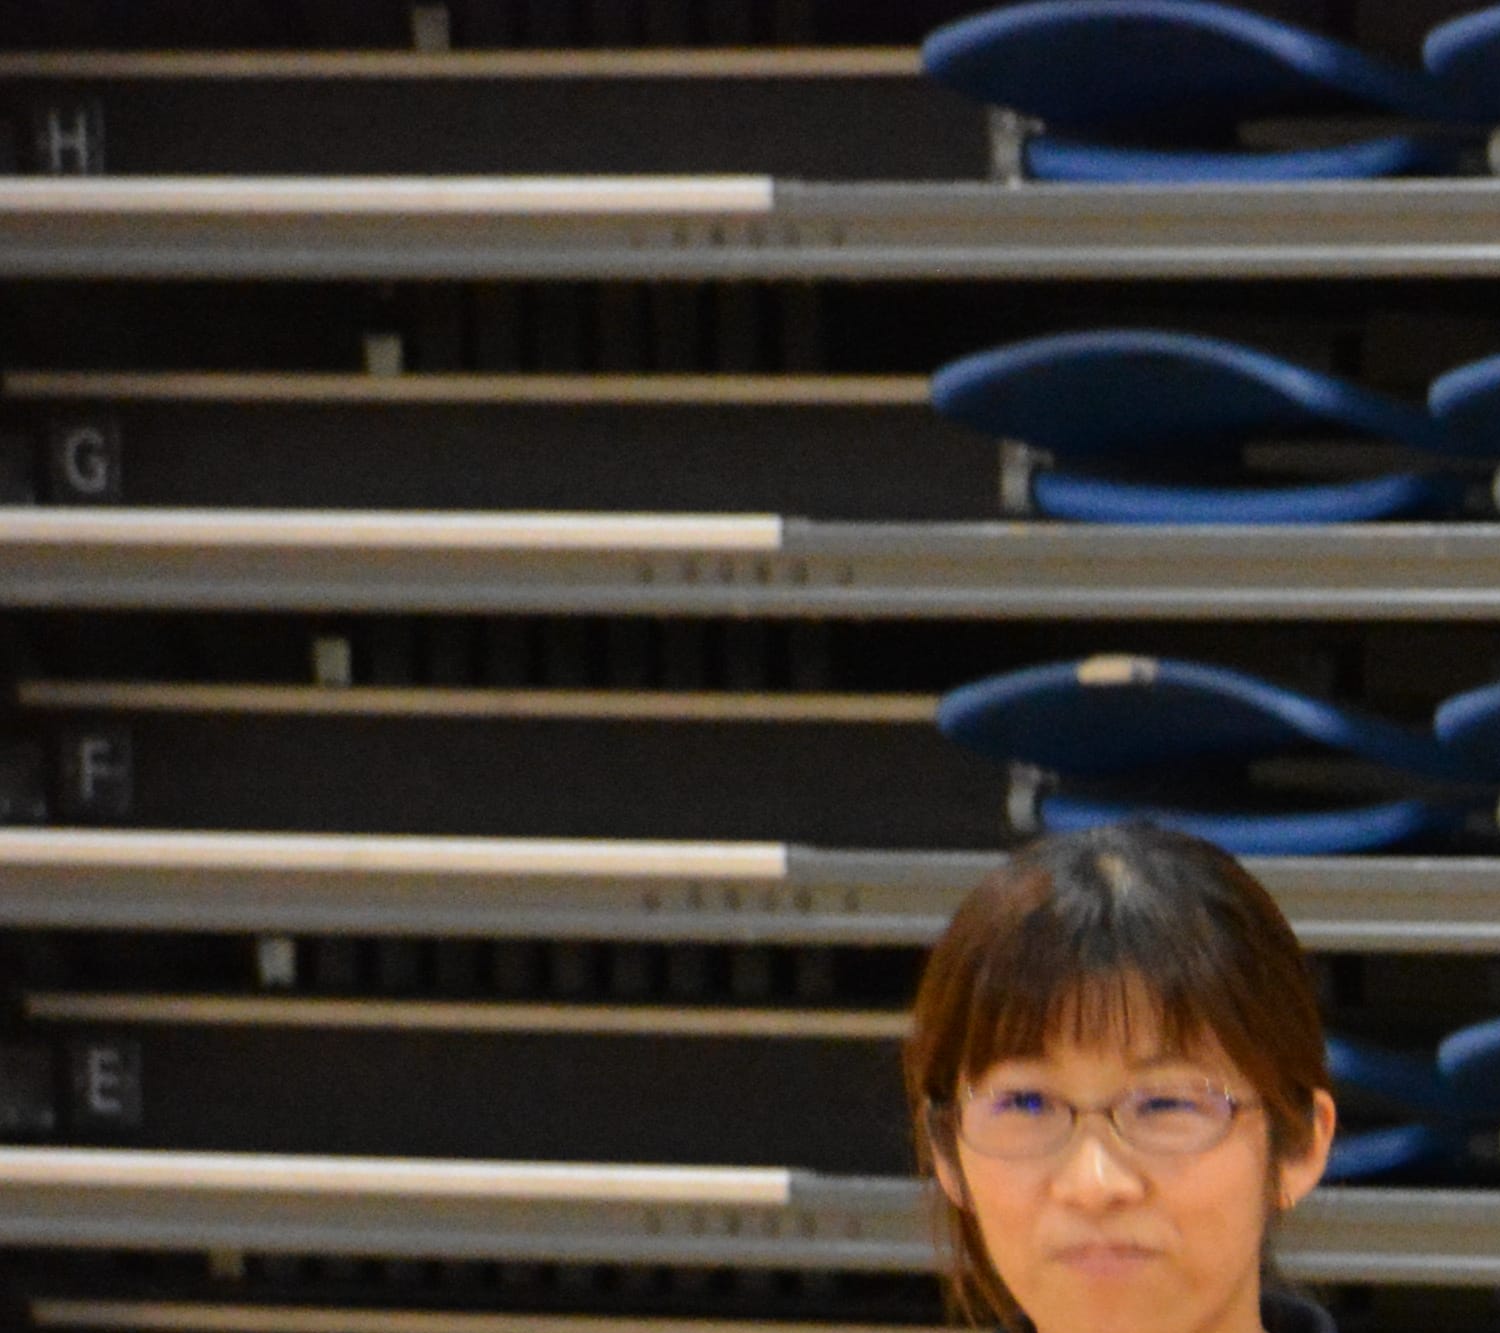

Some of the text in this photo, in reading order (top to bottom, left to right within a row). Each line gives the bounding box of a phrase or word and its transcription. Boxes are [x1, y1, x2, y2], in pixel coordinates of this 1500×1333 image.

[48, 110, 88, 175] H
[65, 428, 107, 494] G
[89, 1049, 121, 1112] E
